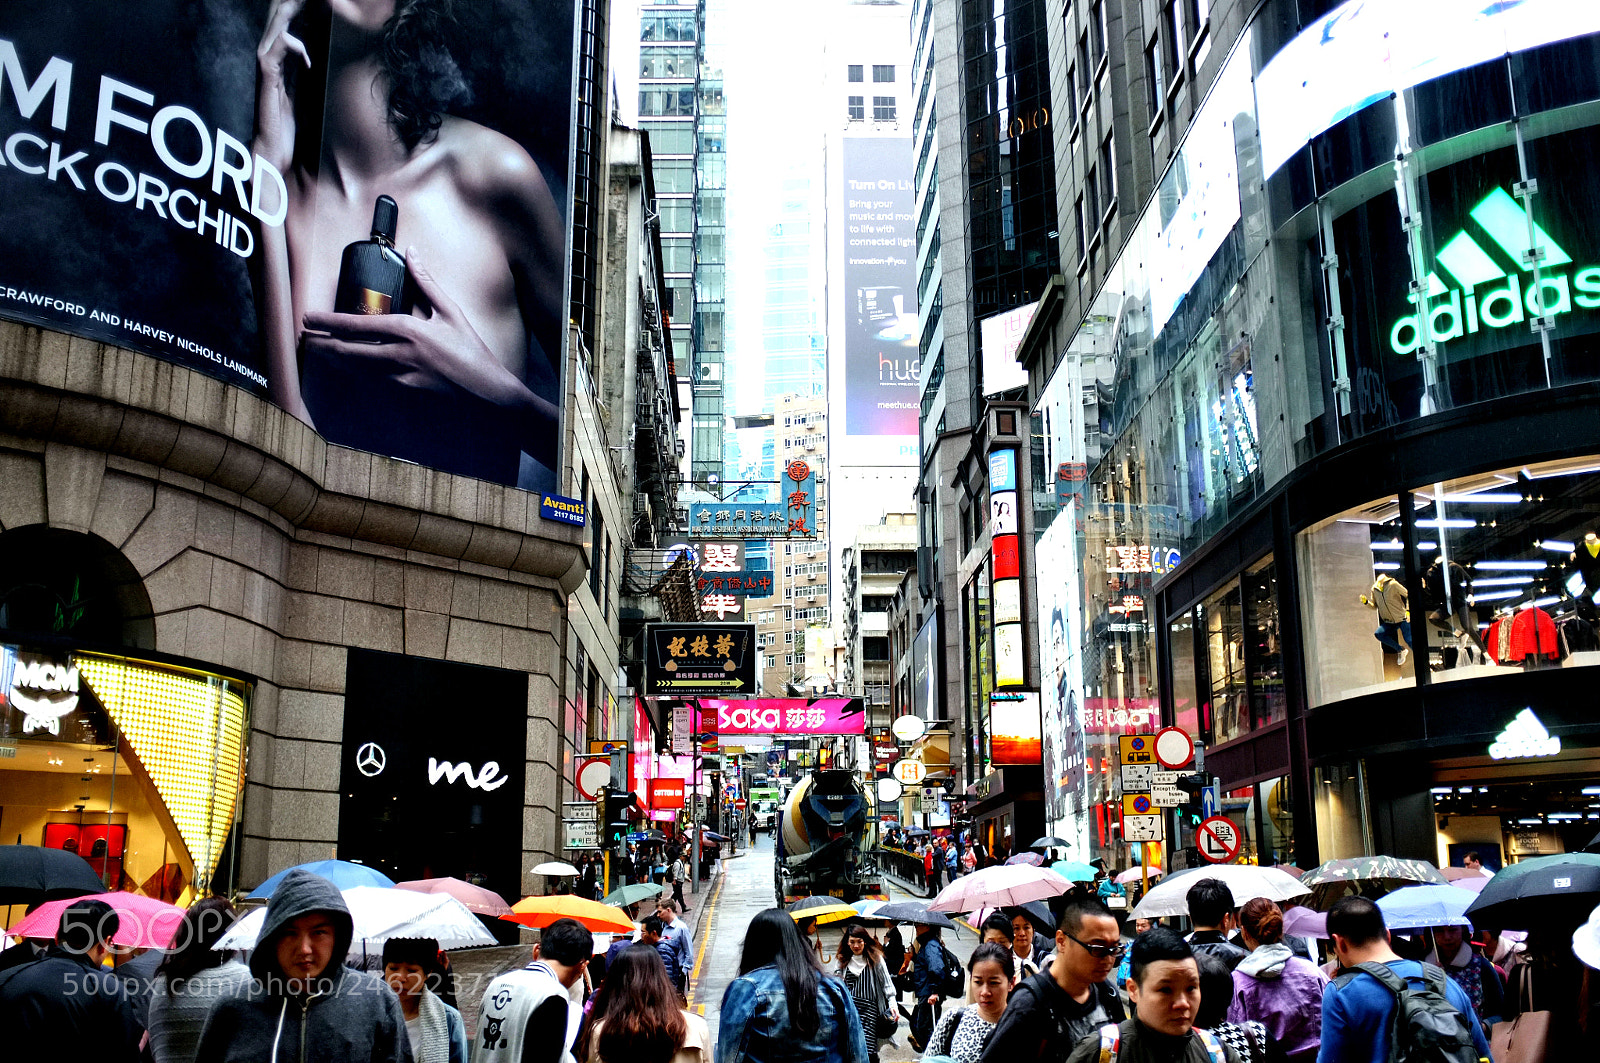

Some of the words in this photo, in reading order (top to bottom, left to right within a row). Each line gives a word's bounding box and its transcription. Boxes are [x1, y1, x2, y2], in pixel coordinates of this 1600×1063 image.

[94, 75, 288, 227] FORD
[848, 179, 875, 190] Turn
[877, 179, 895, 190] On
[0, 132, 89, 191] CK
[94, 162, 254, 258] ORCHID
[849, 200, 872, 209] Bring
[873, 202, 893, 210] your
[849, 212, 875, 221] music
[876, 212, 893, 221] and
[849, 225, 859, 233] to
[860, 224, 875, 233] life
[876, 224, 895, 233] with
[849, 237, 895, 246] connected
[1390, 267, 1600, 354] adidas
[89, 310, 120, 326] AND
[124, 319, 175, 344] HARVEY
[177, 337, 222, 364] NICHOLS
[223, 356, 268, 389] LANDMARK
[879, 352, 921, 381] hue
[543, 496, 585, 515] Avanti
[554, 510, 569, 519] 2117
[787, 490, 811, 533] 寧波
[12, 661, 79, 692] MCM
[785, 707, 826, 729] 莎莎
[428, 757, 508, 791] me
[1144, 766, 1151, 774] 7
[1148, 817, 1154, 826] 7
[1148, 831, 1155, 839] 7
